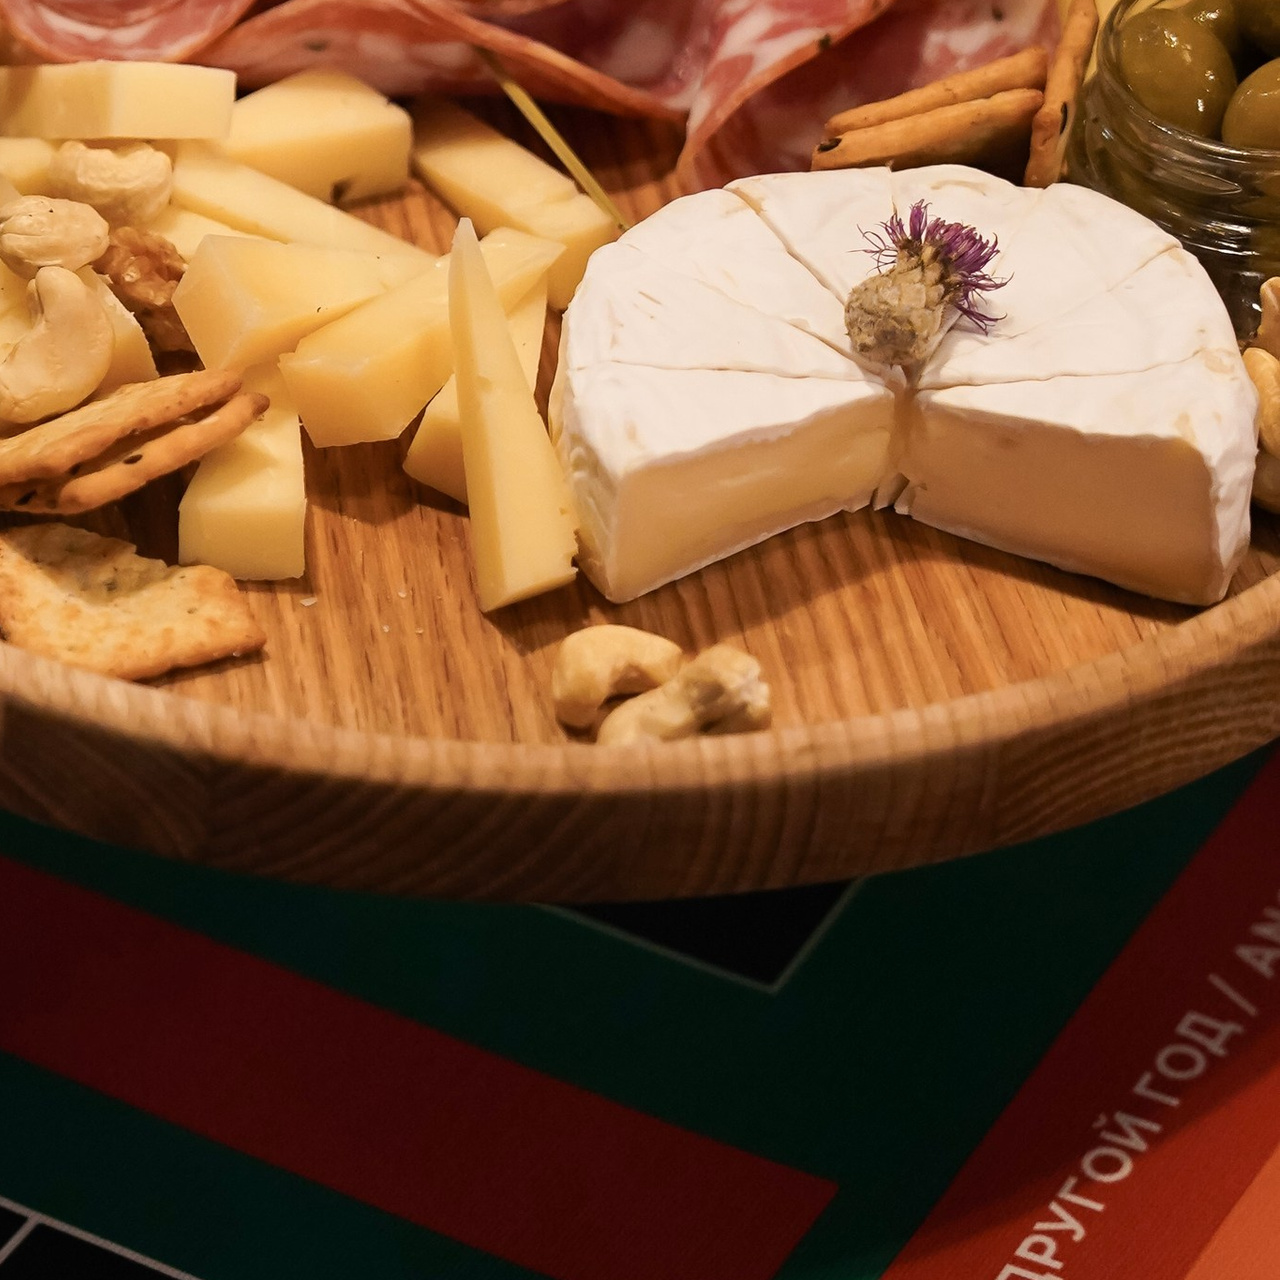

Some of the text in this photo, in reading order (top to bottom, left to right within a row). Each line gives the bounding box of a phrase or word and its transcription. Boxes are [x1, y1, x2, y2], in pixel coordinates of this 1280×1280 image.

[1133, 1011, 1245, 1108] ГОД
[1209, 972, 1258, 1017] /
[1234, 885, 1280, 980] AN
